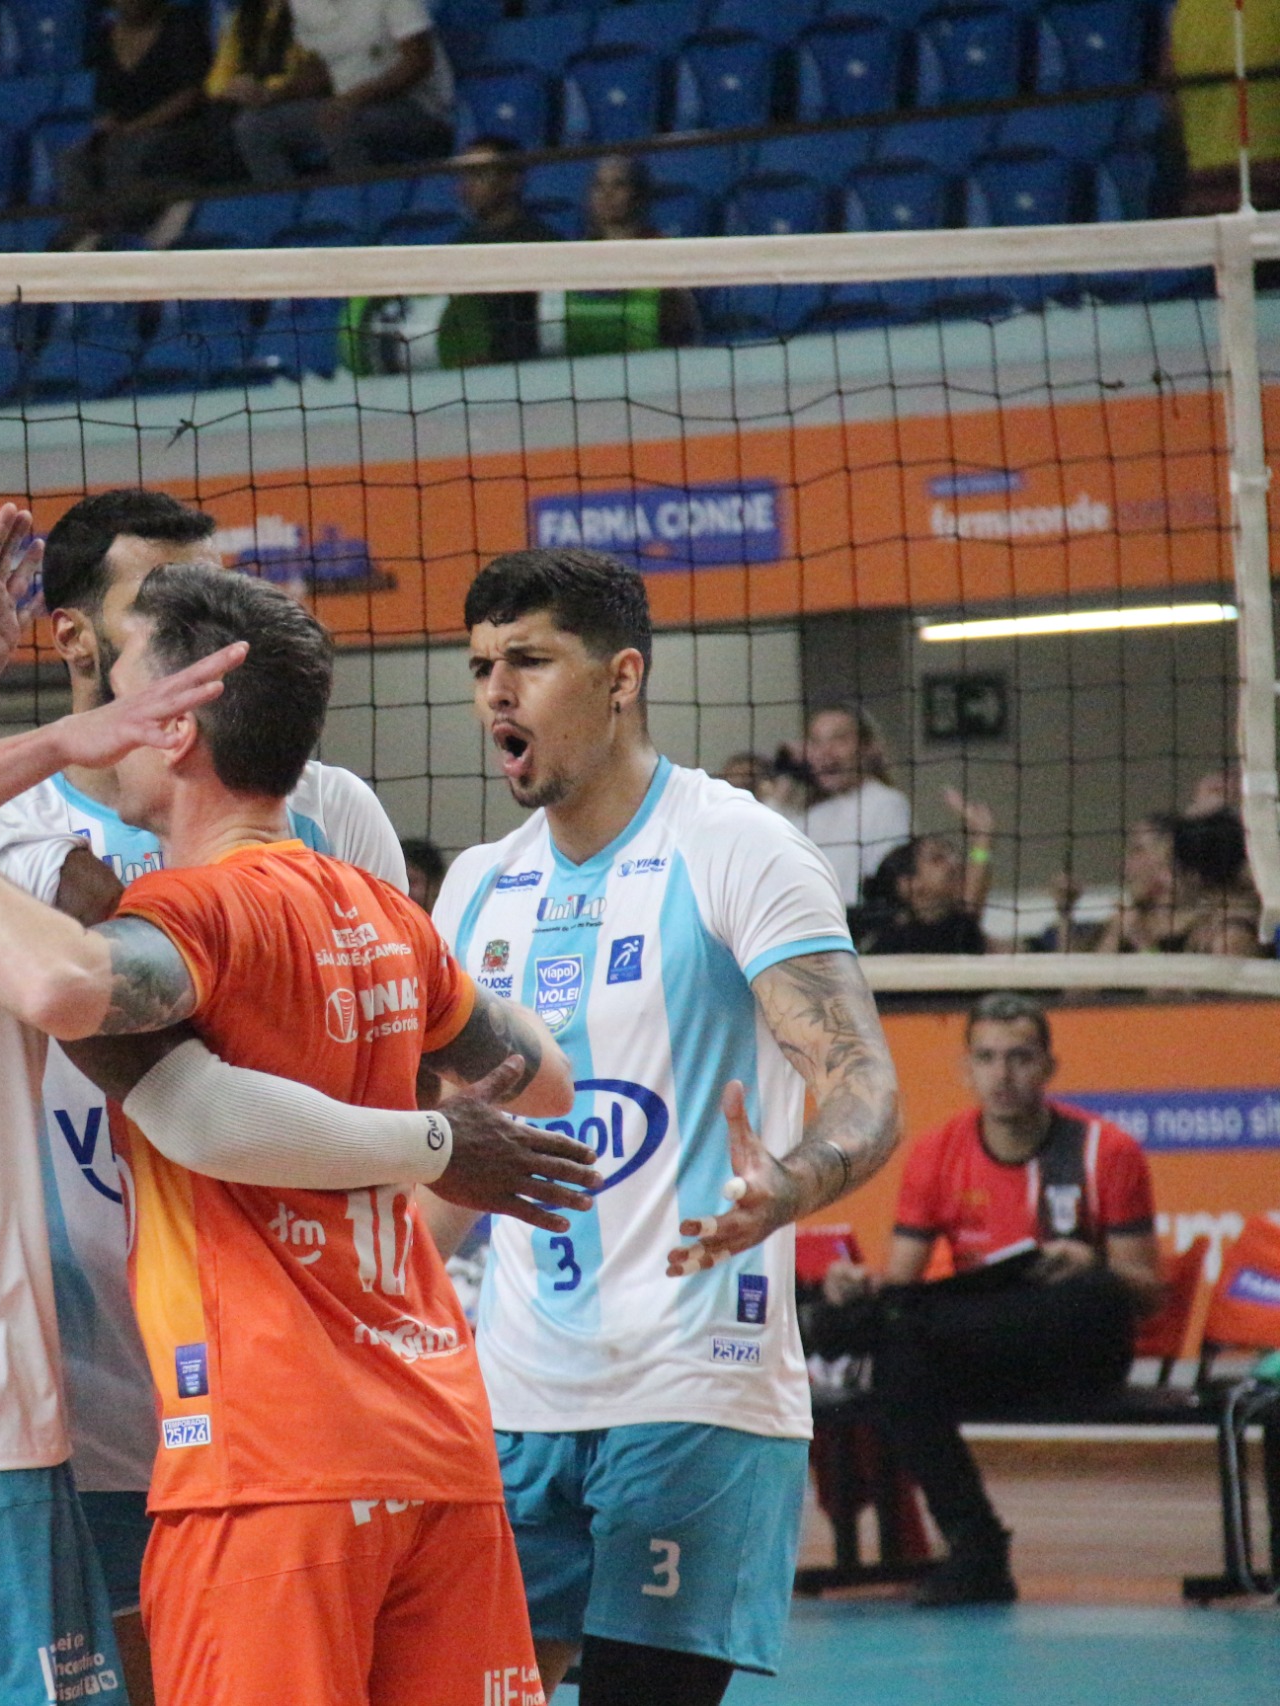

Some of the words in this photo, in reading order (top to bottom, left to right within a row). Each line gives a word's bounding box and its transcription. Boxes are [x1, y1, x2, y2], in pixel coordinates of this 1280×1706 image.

[538, 503, 654, 548] FARMA
[656, 492, 774, 540] CONDE
[489, 974, 513, 989] JOSÉ
[539, 964, 575, 982] Viapol
[1153, 1105, 1245, 1144] nosso
[549, 1236, 582, 1291] 3
[167, 1426, 207, 1446] 25/26
[641, 1538, 680, 1597] 3
